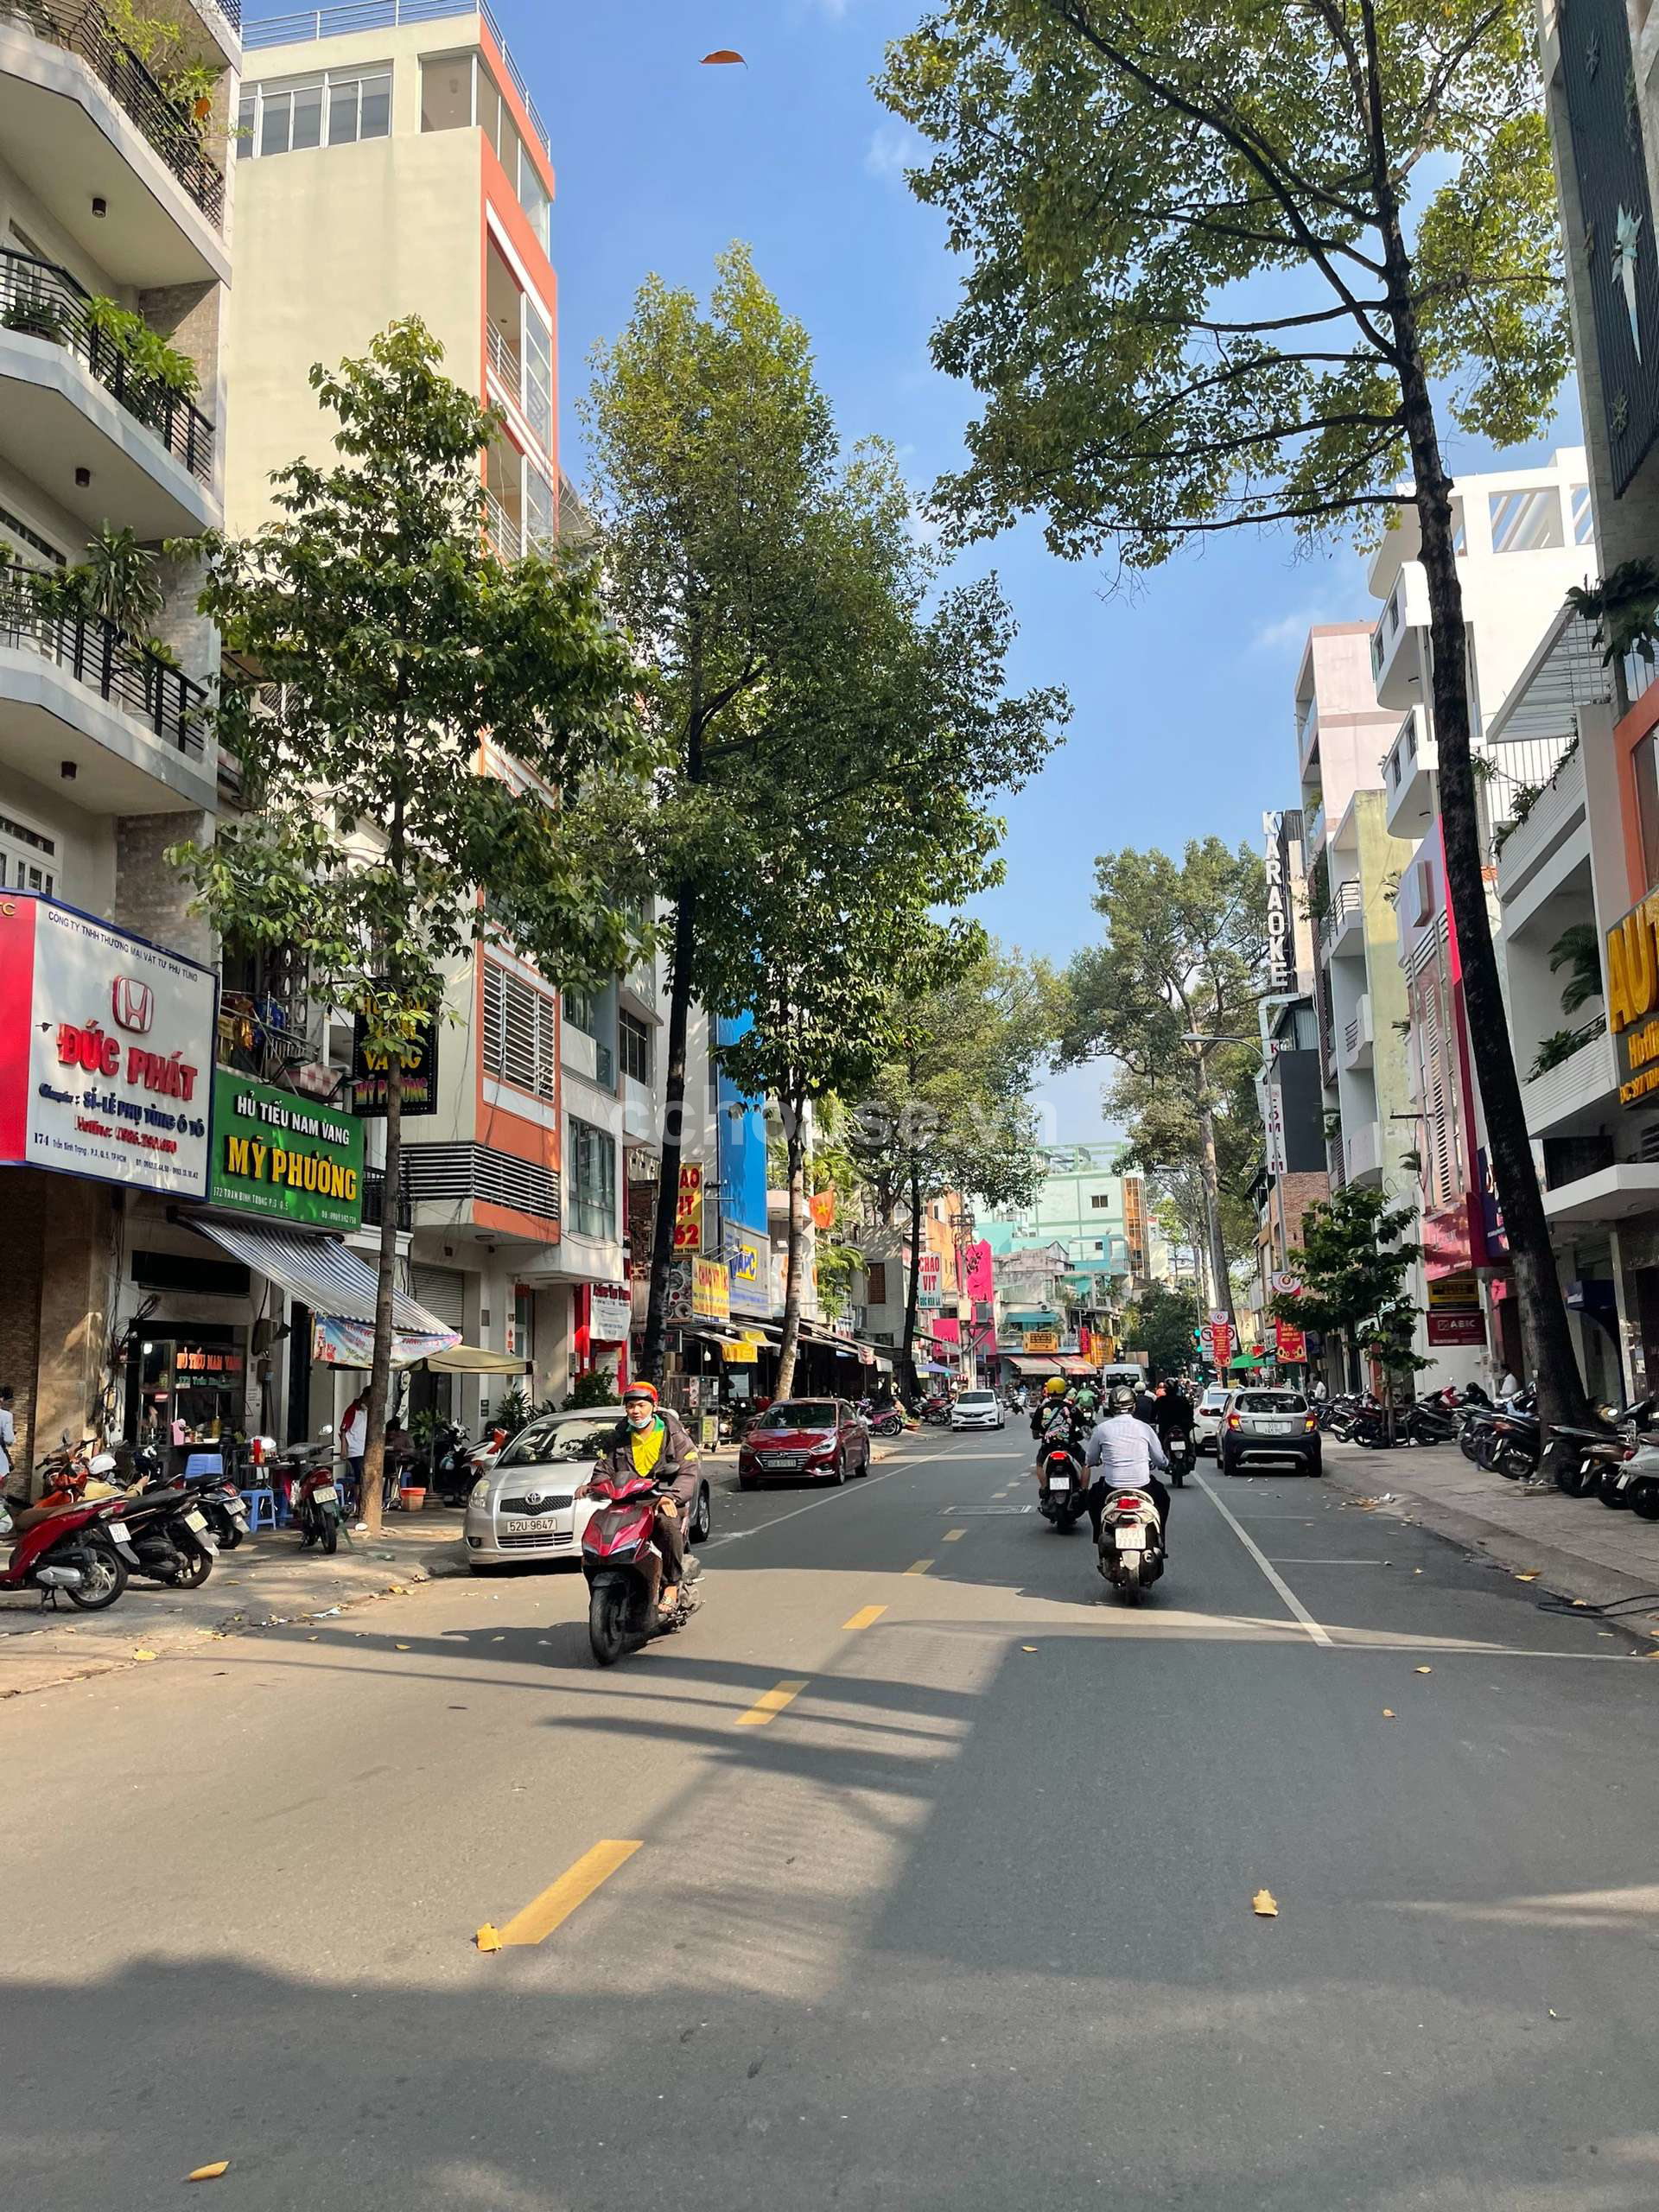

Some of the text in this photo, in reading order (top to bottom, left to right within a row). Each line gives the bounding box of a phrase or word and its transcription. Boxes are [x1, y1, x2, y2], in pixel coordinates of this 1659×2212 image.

[1262, 810, 1288, 987] KARAOKE
[70, 920, 81, 931] TY
[81, 925, 99, 941] TNHH
[56, 1018, 198, 1101] ĐỨC PHÁT
[34, 1132, 49, 1146] 174
[237, 1090, 257, 1116] HỦ
[259, 1100, 289, 1127] TIẾU
[292, 1112, 319, 1136] NAM
[228, 1135, 267, 1179] MỸ
[272, 1147, 357, 1200] PHƯƠNG
